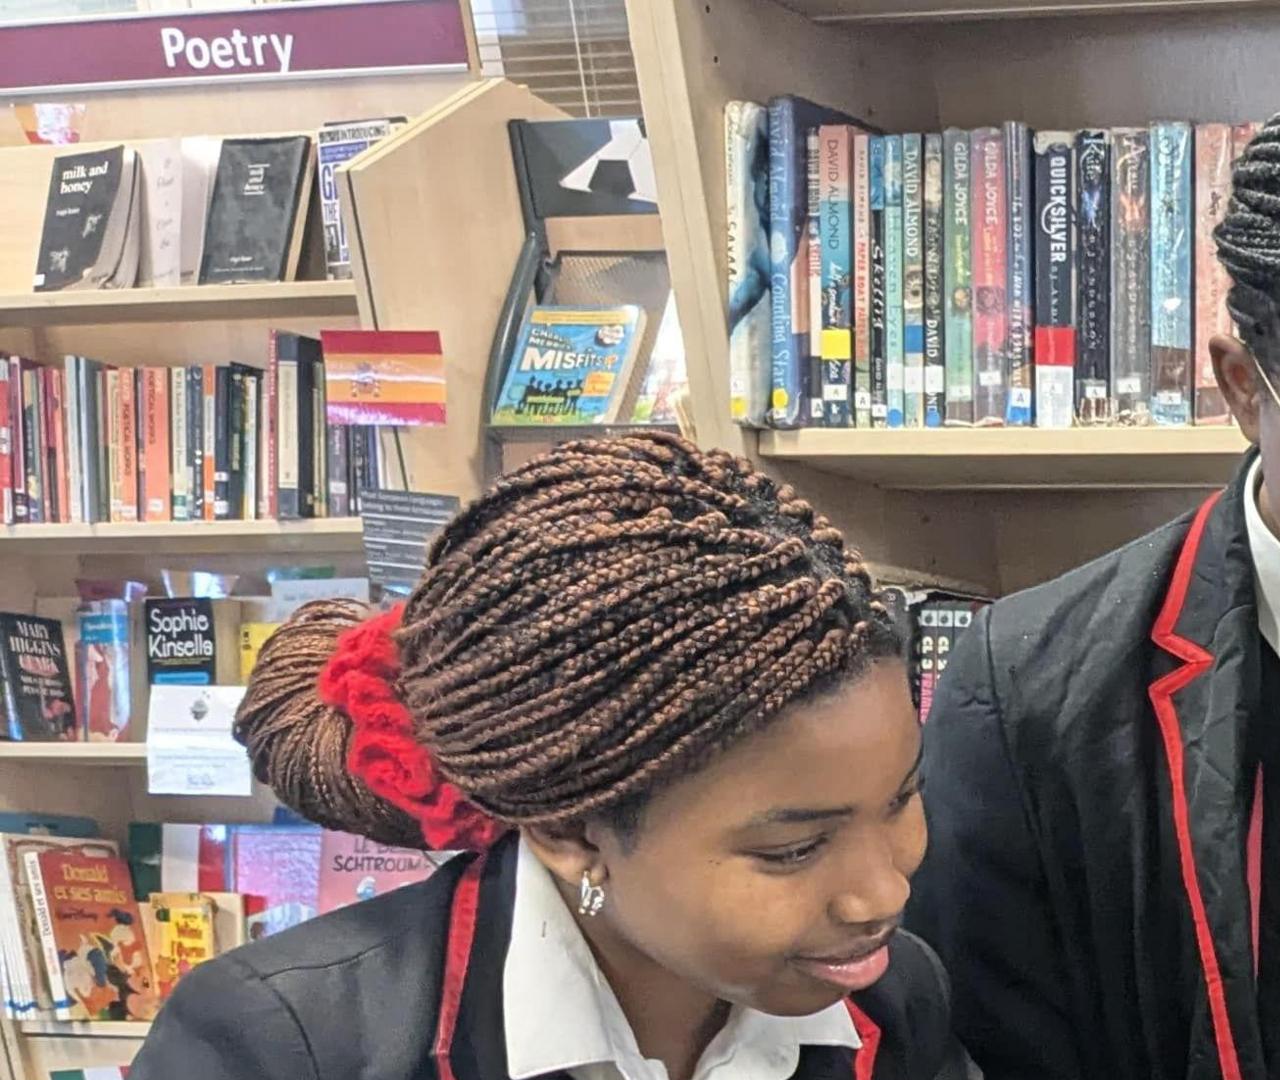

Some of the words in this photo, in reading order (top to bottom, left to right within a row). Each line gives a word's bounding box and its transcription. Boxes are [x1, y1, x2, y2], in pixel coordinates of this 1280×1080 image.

[162, 27, 294, 72] Poetry
[63, 166, 87, 180] milk
[89, 161, 109, 176] and
[827, 138, 841, 182] DAVID
[905, 151, 920, 194] DAVID
[953, 142, 967, 180] GILDA
[984, 141, 998, 178] GILDA
[60, 181, 93, 195] honey
[953, 183, 967, 225] JOYCE
[984, 182, 998, 224] JOYCE
[826, 186, 841, 250] ALMOND
[906, 198, 921, 257] ALMOND
[1041, 156, 1068, 263] QUICKSILVER
[927, 319, 939, 358] DAVID
[520, 346, 603, 372] MISFITS
[151, 607, 209, 638] Sophie
[149, 634, 214, 658] Kinsella
[61, 863, 109, 883] Donald
